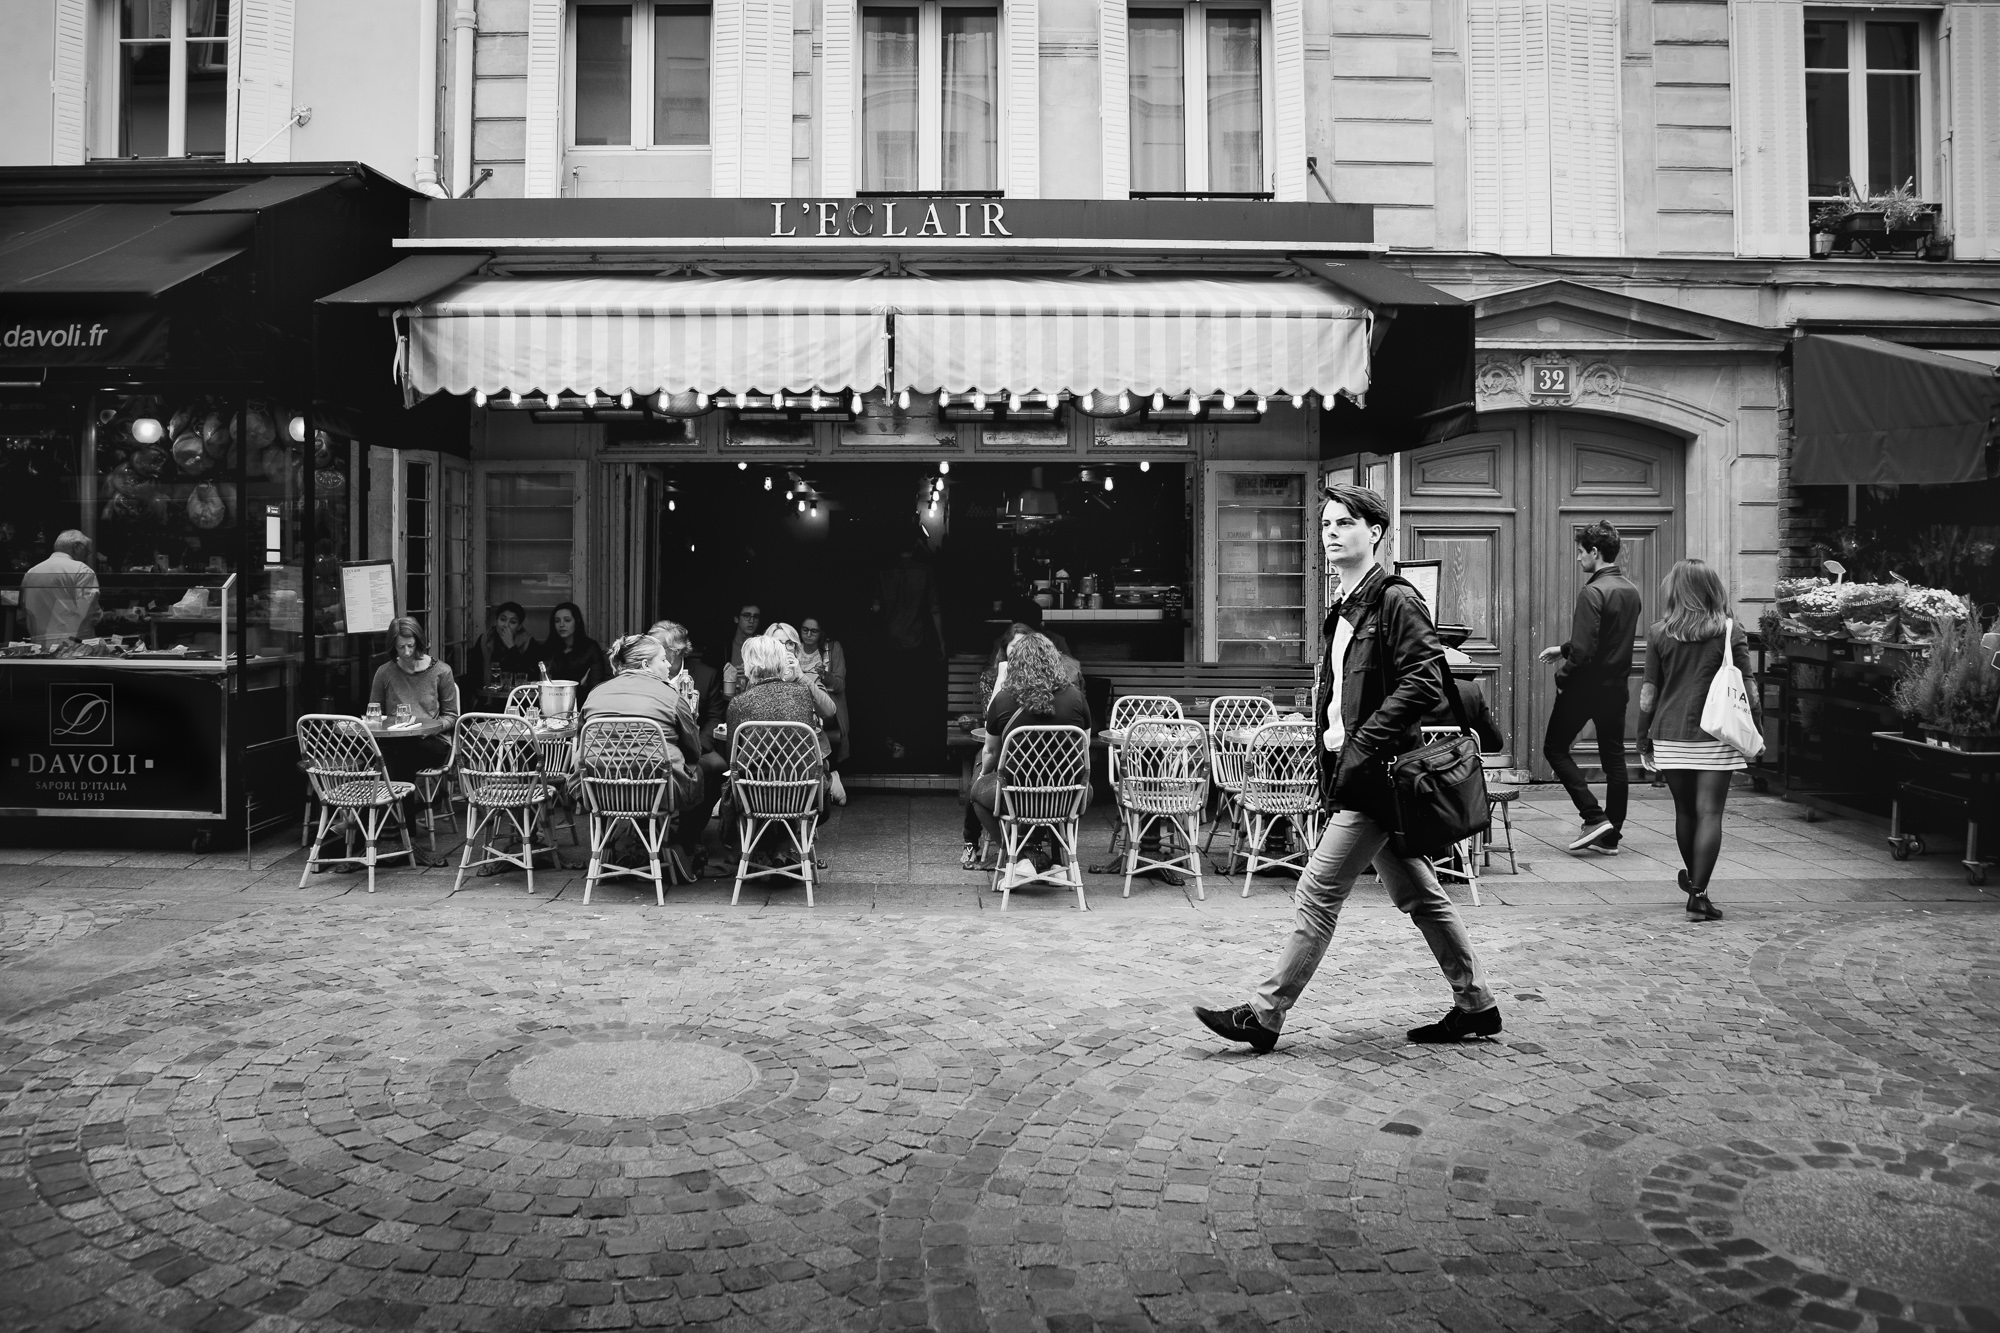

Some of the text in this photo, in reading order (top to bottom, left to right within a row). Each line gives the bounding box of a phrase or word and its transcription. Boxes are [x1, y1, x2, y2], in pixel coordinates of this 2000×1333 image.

[770, 202, 1013, 237] L'ECLAIR
[0, 323, 109, 347] davoli.fr
[1539, 369, 1565, 390] 32
[28, 753, 137, 775] DAVOLI
[35, 781, 127, 791] SAPORI D'ITALIA
[58, 792, 105, 802] DAL 1913
